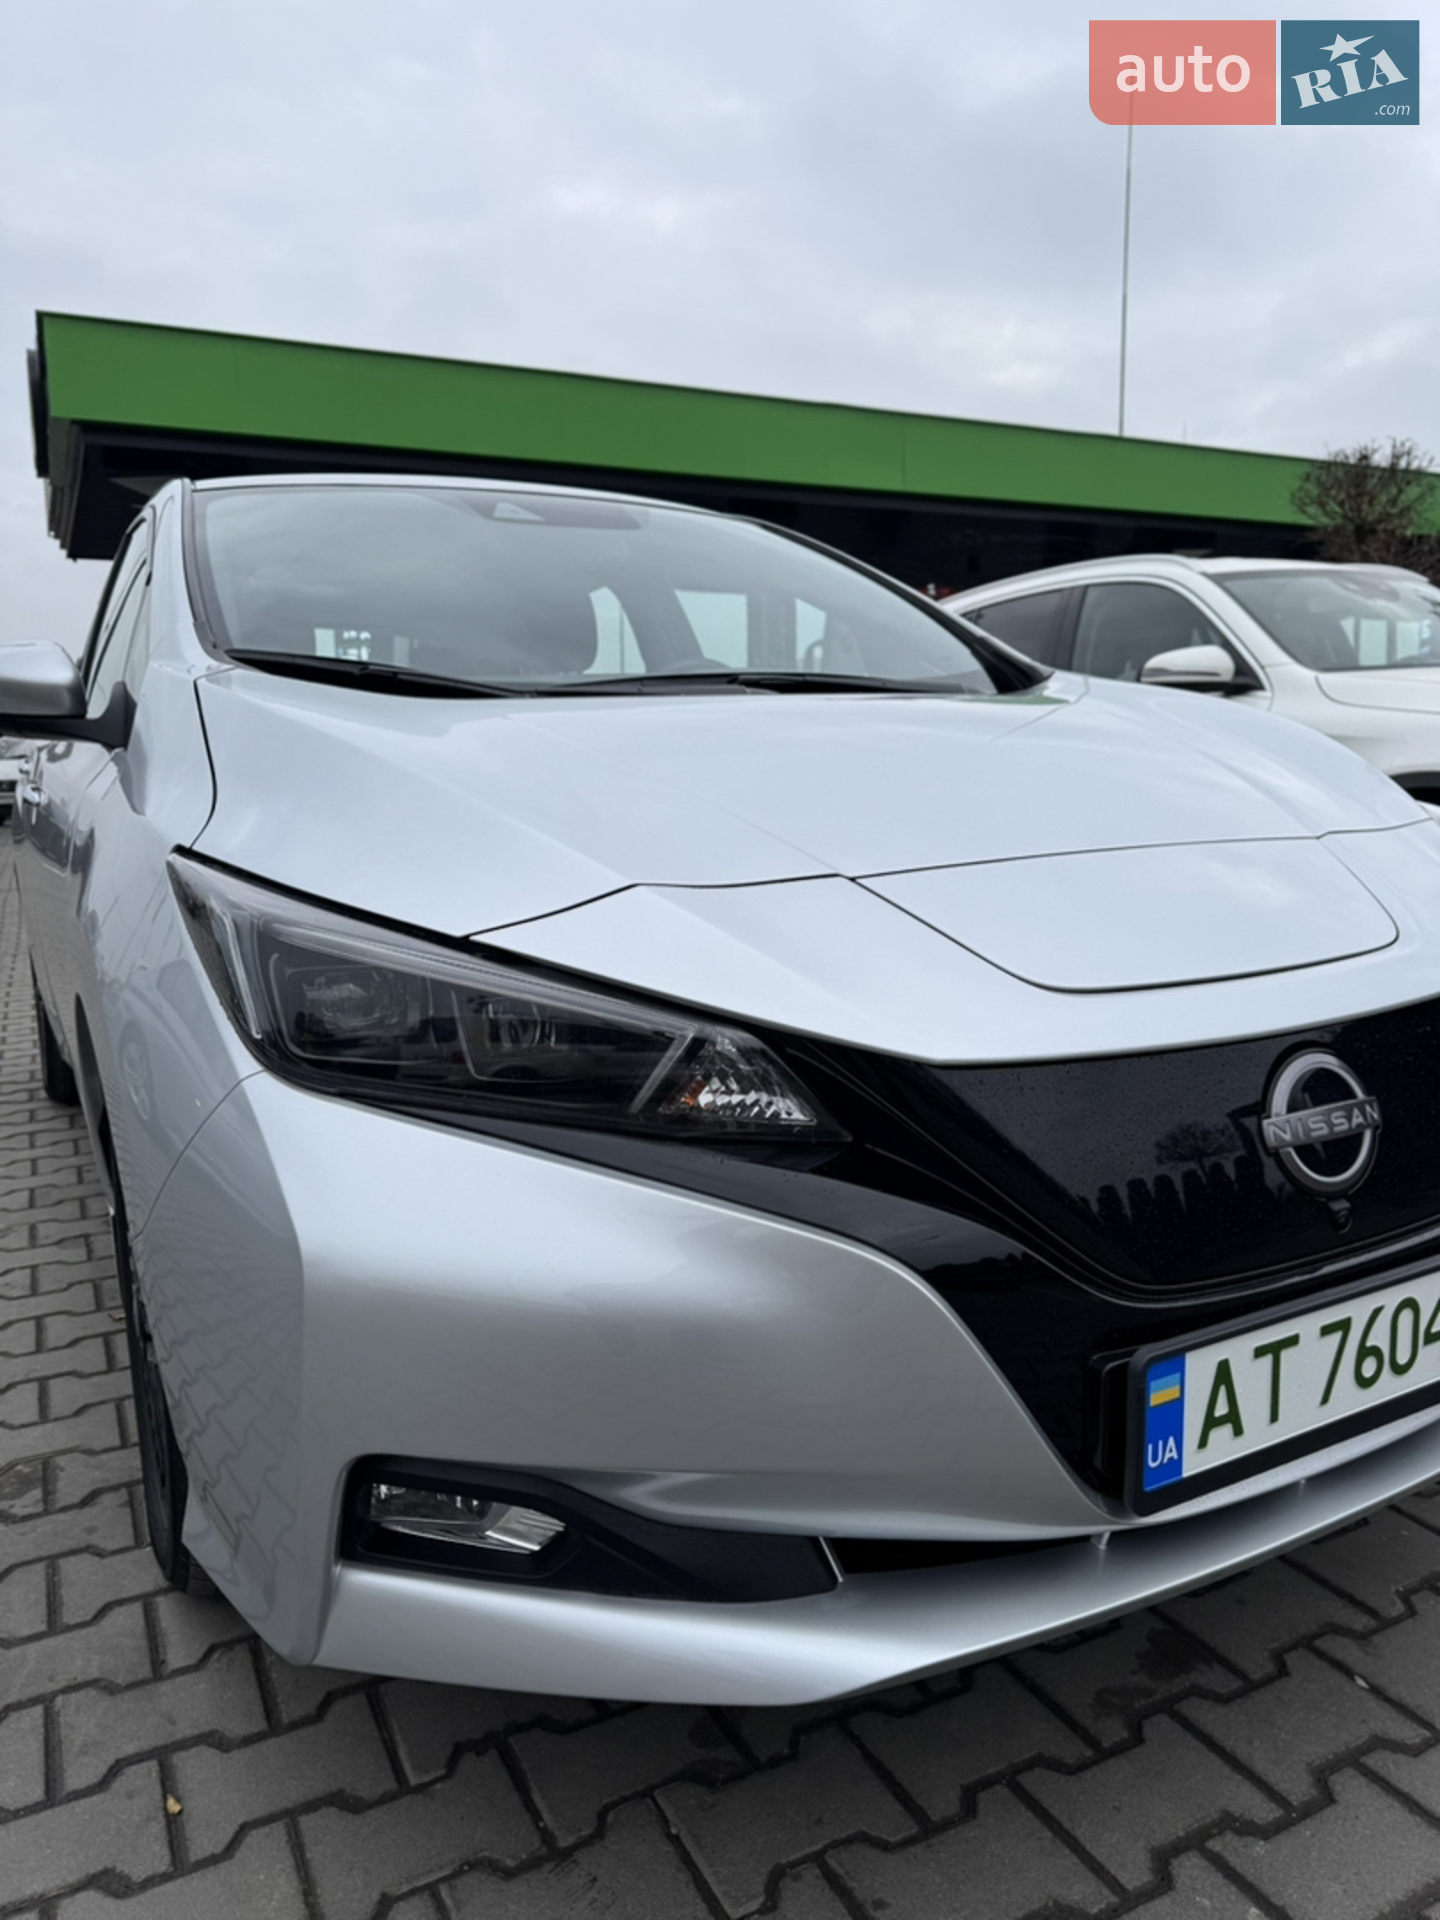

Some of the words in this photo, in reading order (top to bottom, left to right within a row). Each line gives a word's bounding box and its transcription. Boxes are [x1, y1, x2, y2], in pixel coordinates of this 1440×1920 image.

[1269, 1102, 1379, 1144] NISSAN
[1197, 1333, 1300, 1450] AT
[1148, 1436, 1178, 1468] UA
